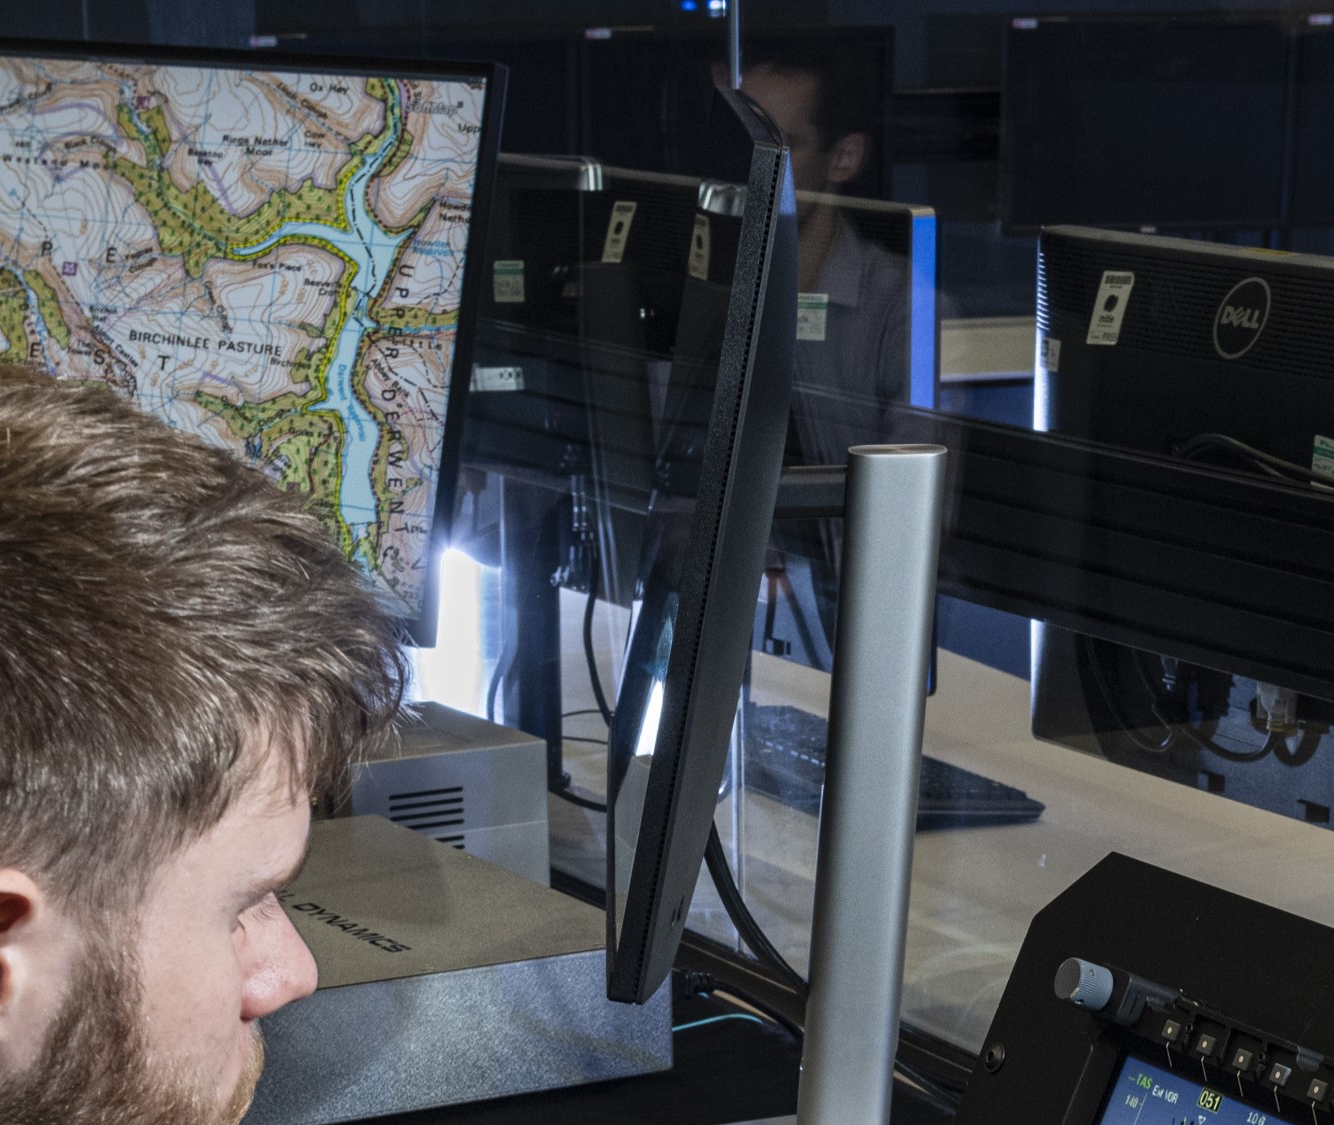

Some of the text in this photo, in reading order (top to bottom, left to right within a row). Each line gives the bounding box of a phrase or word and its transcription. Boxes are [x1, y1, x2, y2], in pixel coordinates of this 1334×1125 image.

[310, 82, 323, 92] Ox
[1220, 305, 1260, 329] DELL
[129, 330, 282, 357] BIRCHINLEE PASTURE
[292, 902, 411, 953] DYNAMICS
[1125, 1094, 1139, 1108] 140
[1199, 1090, 1219, 1110] 051
